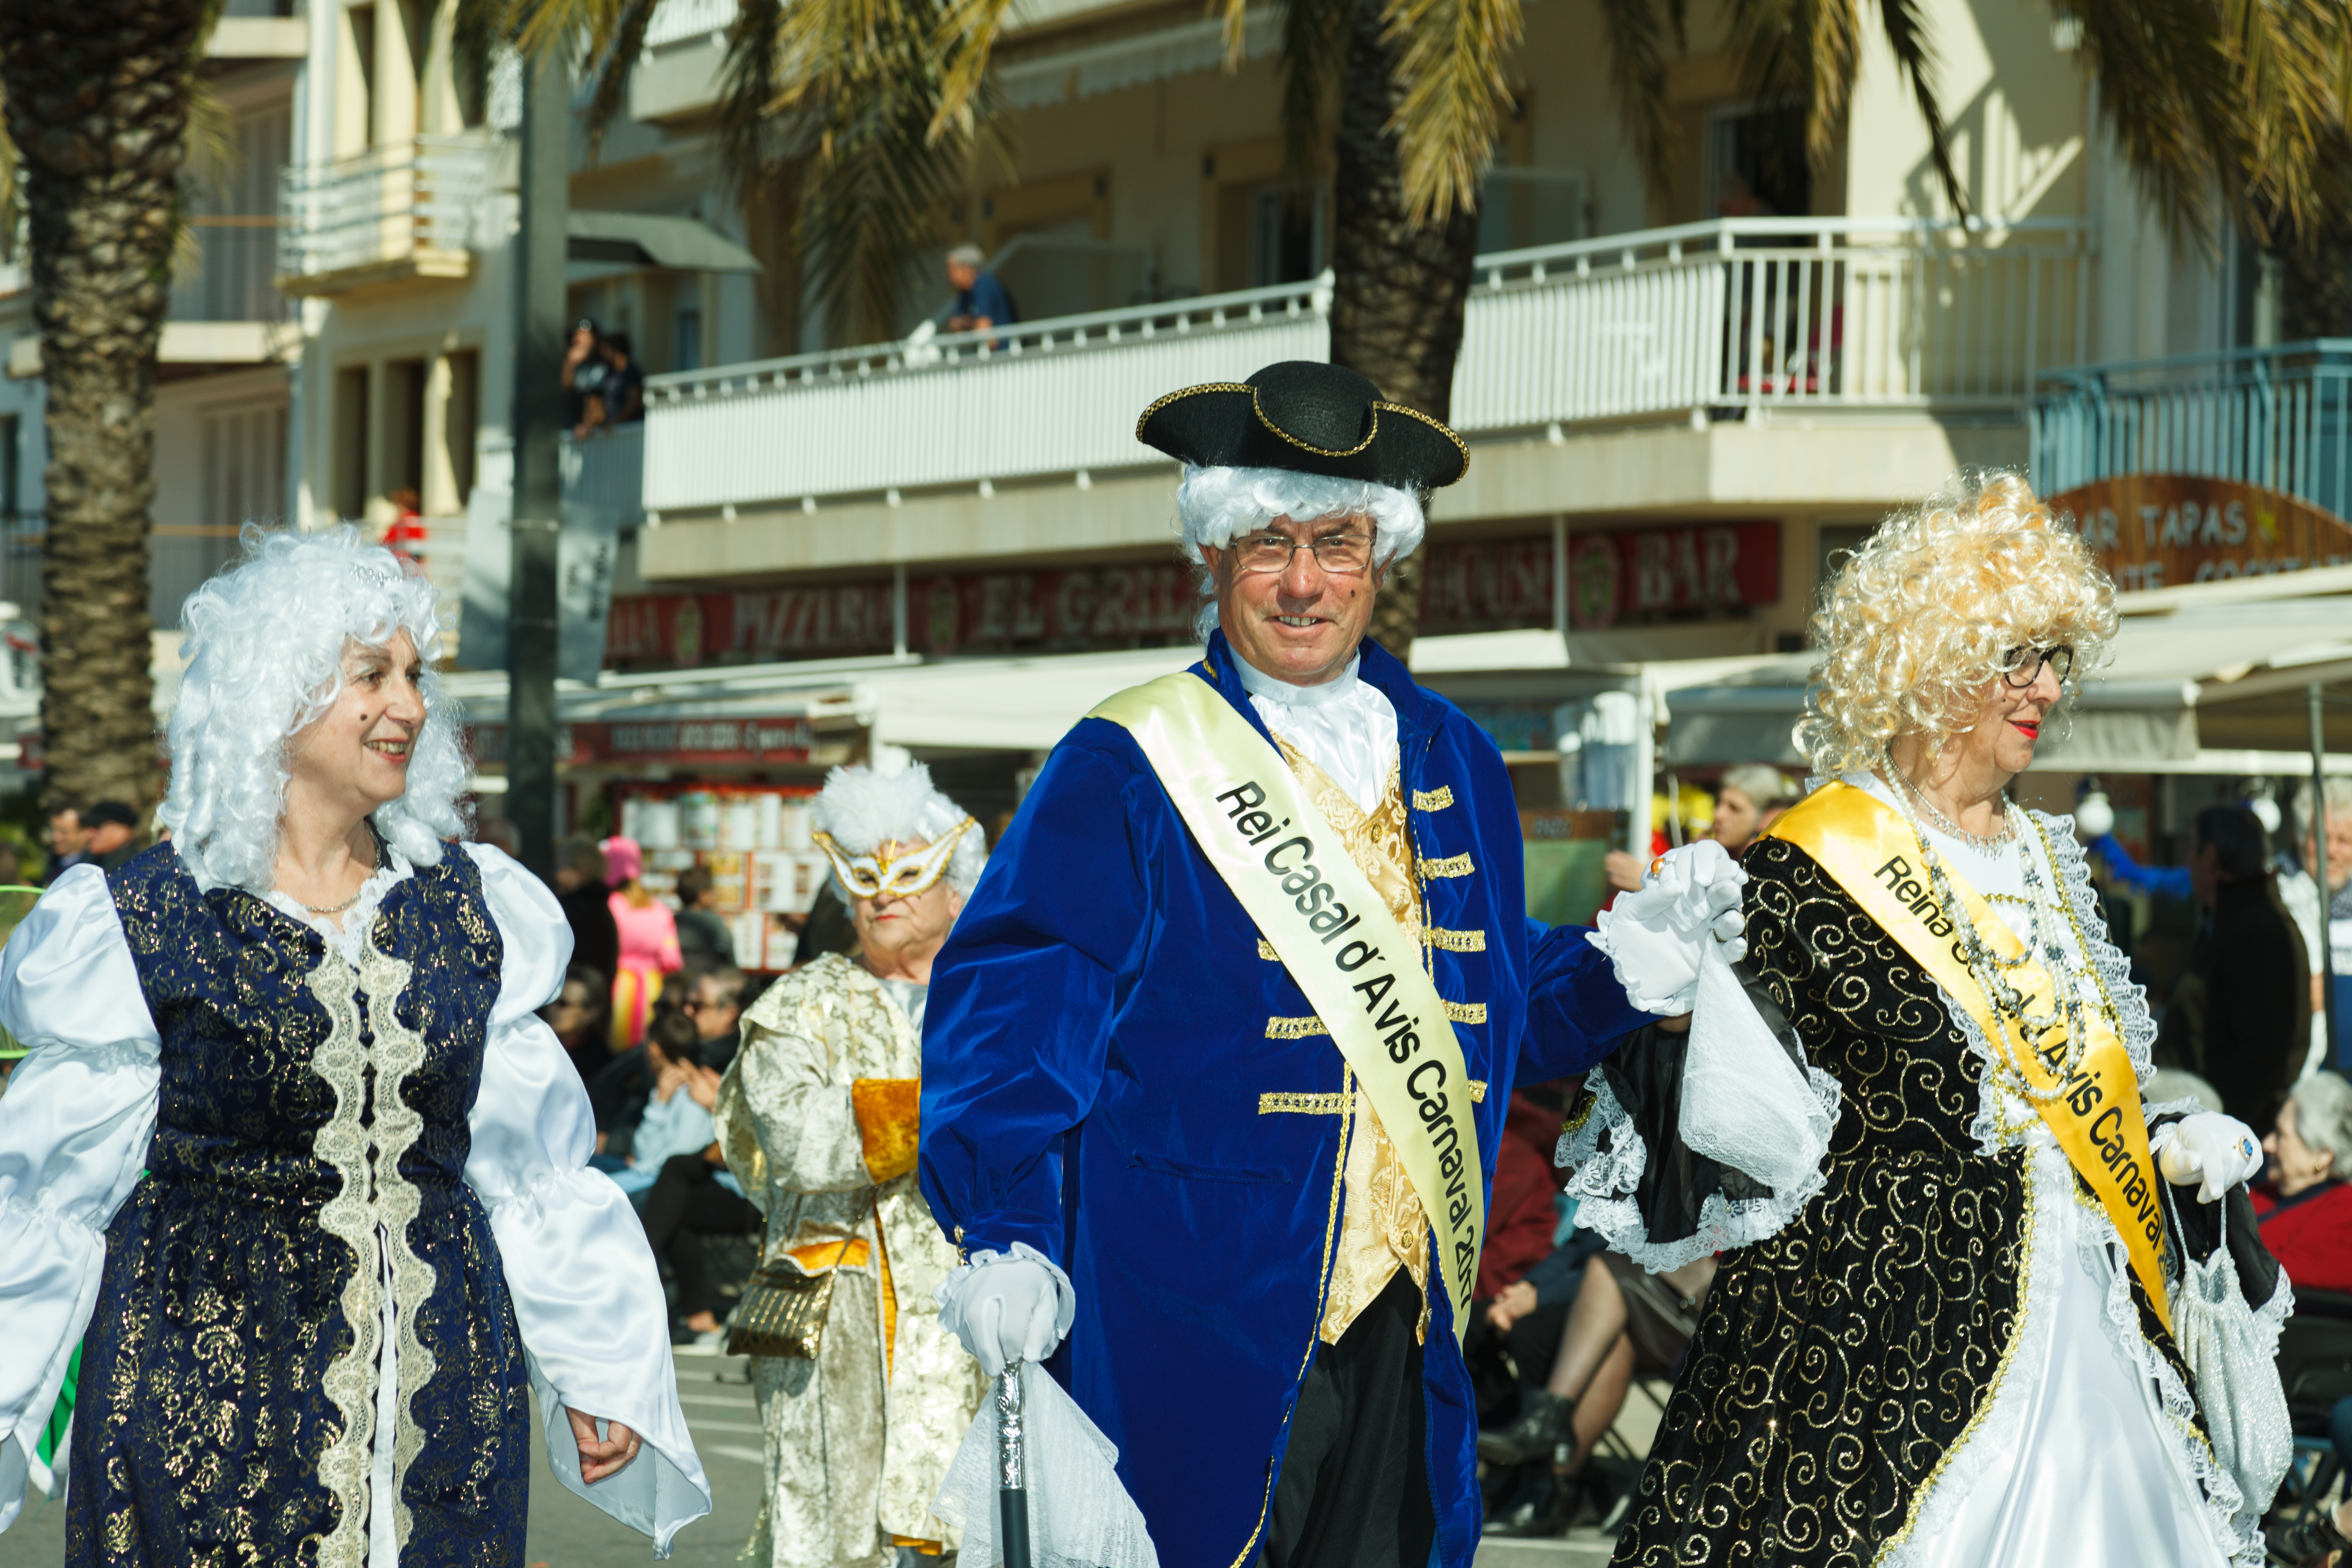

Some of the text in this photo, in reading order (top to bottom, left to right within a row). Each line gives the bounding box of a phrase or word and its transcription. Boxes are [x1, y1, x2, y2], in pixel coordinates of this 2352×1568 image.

[2060, 500, 2249, 550] AR TAPAS
[972, 575, 1044, 637] EL
[1636, 527, 1742, 606] BAR
[1215, 781, 1291, 846] Rei
[1264, 836, 1361, 946] Casal
[1406, 1060, 1473, 1235] Carnaval
[1455, 1225, 1475, 1311] 2017
[1873, 855, 1953, 937] Reina
[2089, 1106, 2163, 1251] Carnaval
